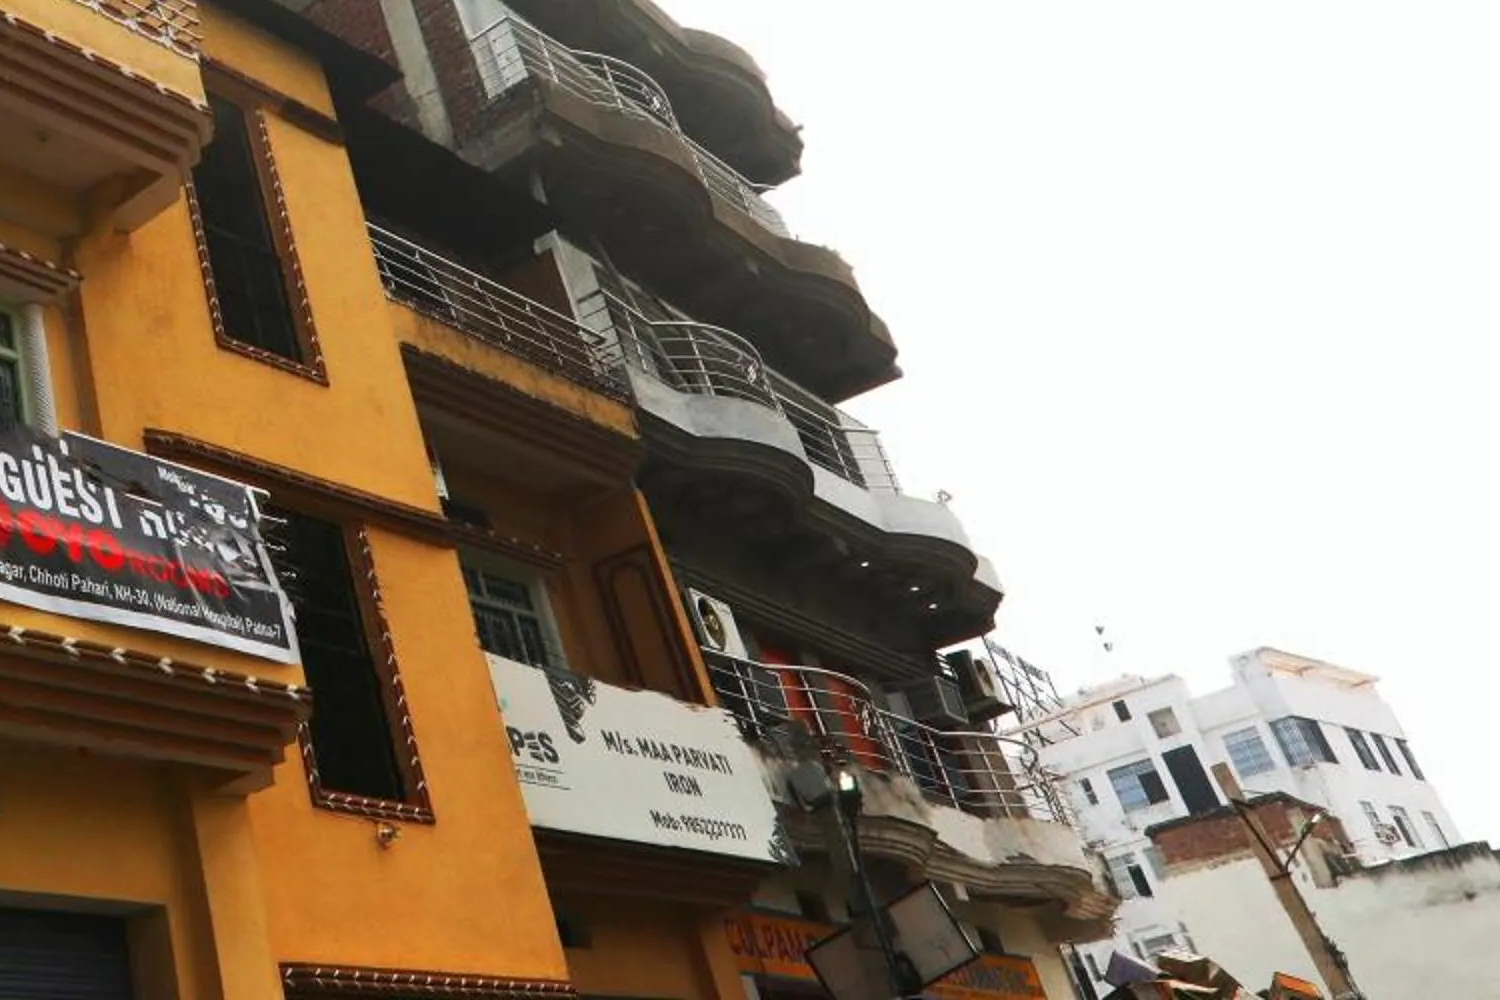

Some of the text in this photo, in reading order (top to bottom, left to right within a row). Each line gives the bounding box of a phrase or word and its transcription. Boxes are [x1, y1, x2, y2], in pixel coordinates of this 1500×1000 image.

[14, 507, 126, 570] OYO
[29, 566, 69, 589] Chhoti
[636, 737, 673, 763] MAA
[670, 744, 734, 775] PARVATI
[663, 771, 703, 796] IRON
